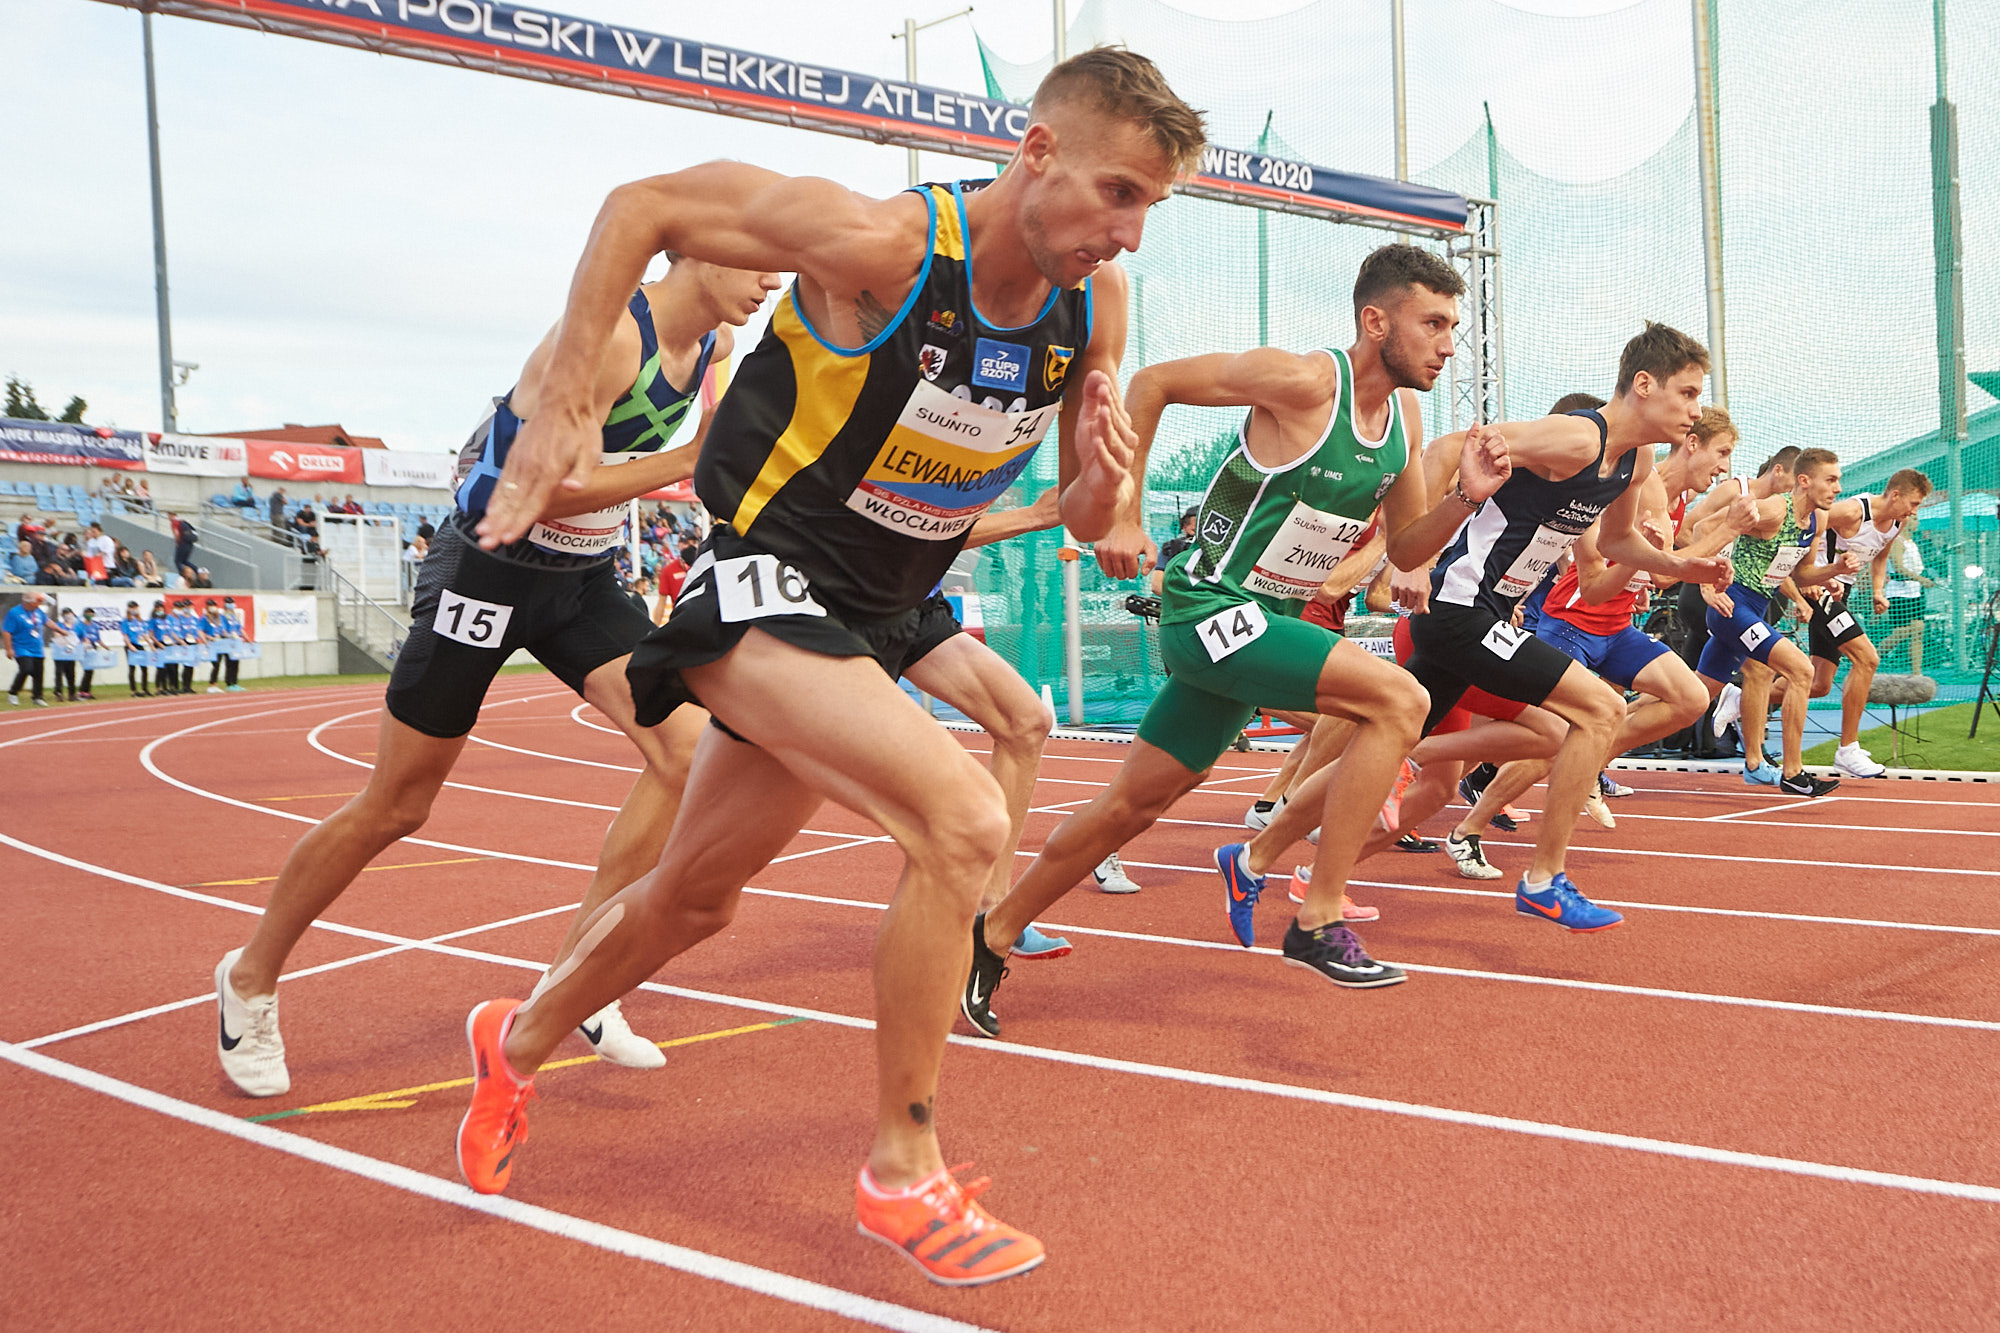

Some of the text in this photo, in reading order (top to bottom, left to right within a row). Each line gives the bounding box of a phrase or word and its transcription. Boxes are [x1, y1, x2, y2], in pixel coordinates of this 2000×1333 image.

[399, 0, 595, 58] POLSKI
[611, 29, 662, 69] W
[673, 42, 849, 104] LEKKIEJ
[1201, 149, 1314, 192] WEK 2020
[915, 407, 1044, 446] SUUNTO 54
[301, 457, 340, 468] ORLEN
[1324, 469, 1343, 480] UMCS
[864, 498, 969, 533] WŁOCŁAWEK
[1293, 517, 1327, 534] SUUNTO
[541, 528, 609, 547] WŁOCŁAWEK
[737, 559, 808, 608] 16
[447, 602, 497, 642] 15
[1208, 609, 1254, 649] 14
[1750, 629, 1760, 641] 4
[1836, 618, 1845, 628] 1
